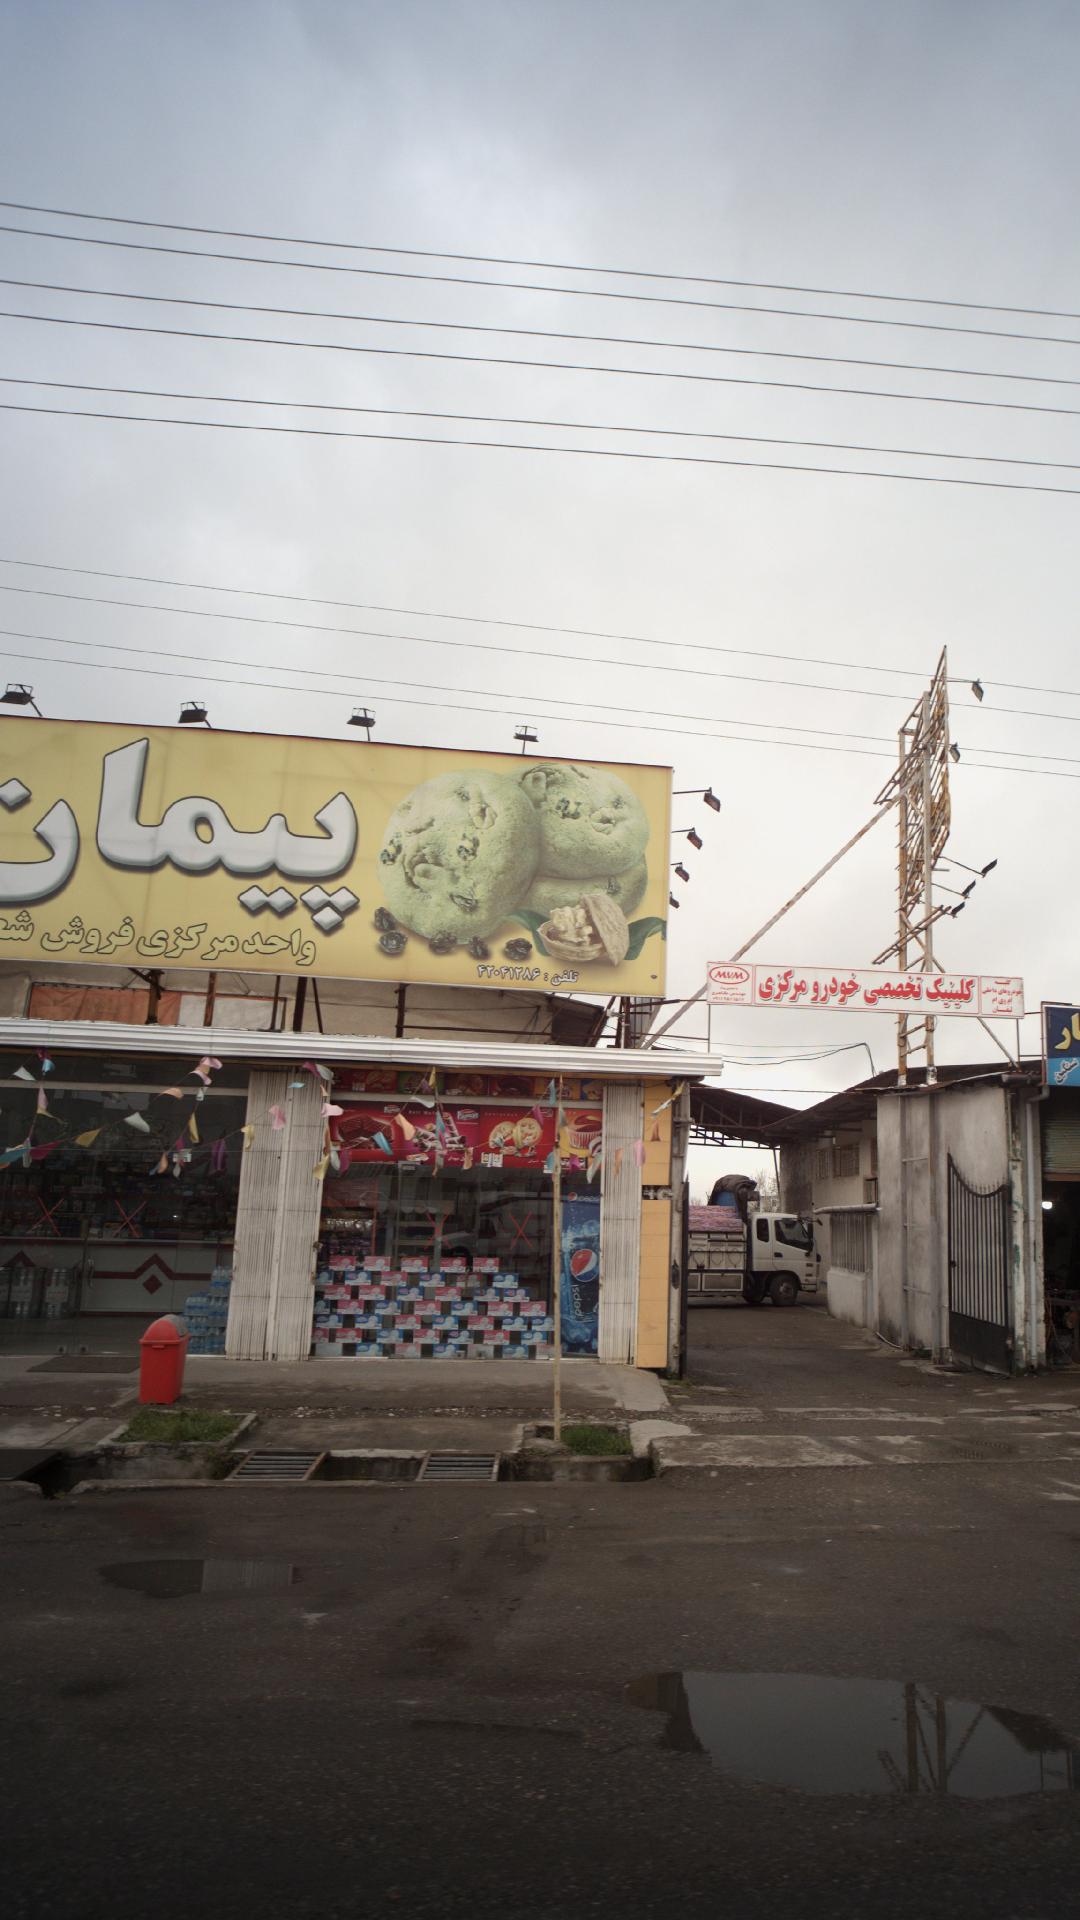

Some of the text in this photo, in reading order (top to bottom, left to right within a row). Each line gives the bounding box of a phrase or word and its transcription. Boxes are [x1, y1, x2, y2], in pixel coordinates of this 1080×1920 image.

[40, 915, 136, 954] فروش
[136, 922, 239, 960] مرکزی
[242, 928, 317, 966] واحد
[758, 970, 975, 1009] کلینیک تخصصی خودرو مرکزی
[1054, 1012, 1080, 1050] ار
